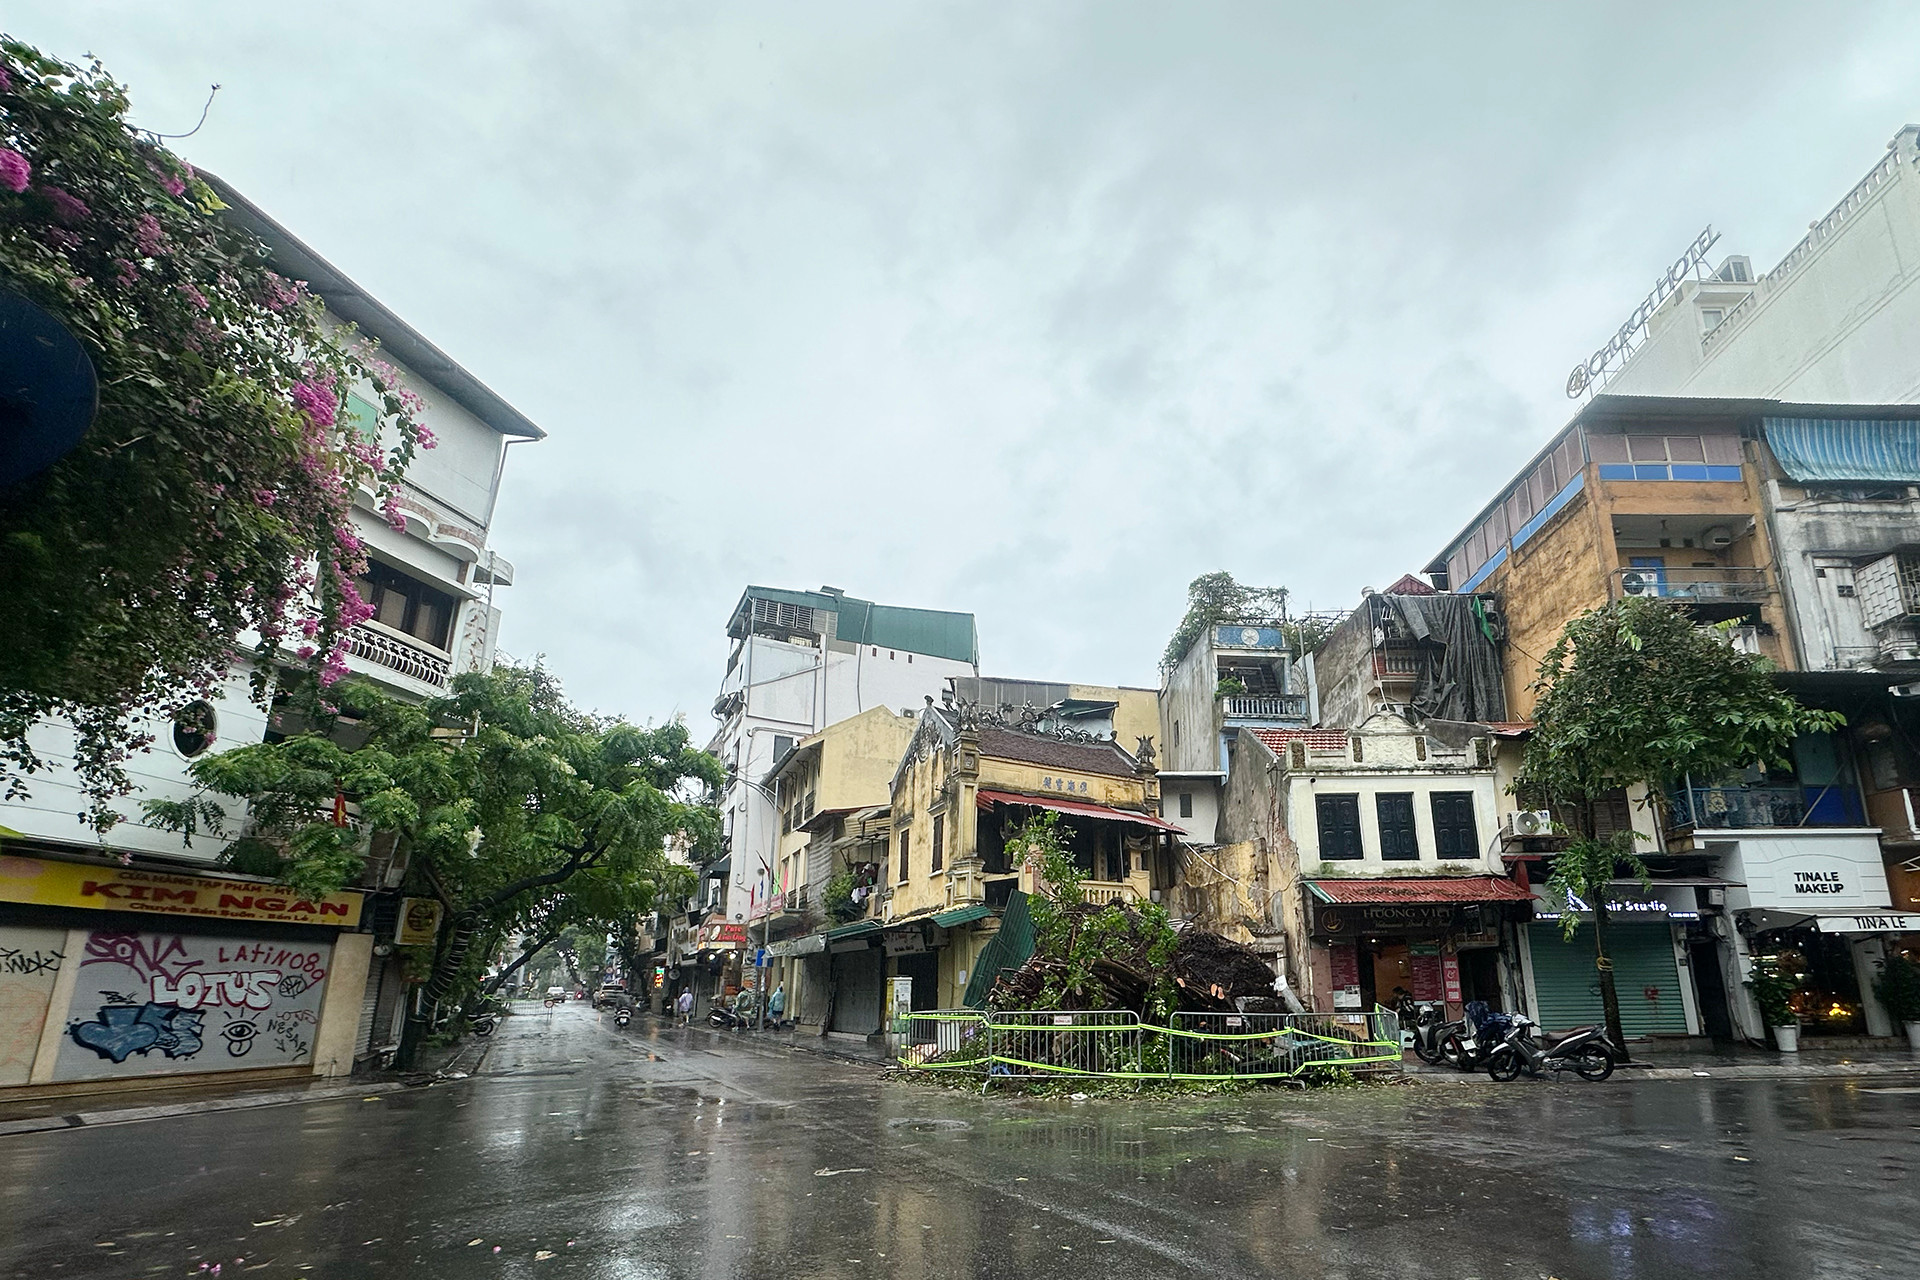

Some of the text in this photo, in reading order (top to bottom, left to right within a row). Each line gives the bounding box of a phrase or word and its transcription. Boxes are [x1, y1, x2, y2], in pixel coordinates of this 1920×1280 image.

[1794, 872, 1839, 882] TINA LE
[81, 881, 197, 905] KIM
[1795, 884, 1844, 893] MAKEUP
[150, 970, 282, 1010] LOTUS
